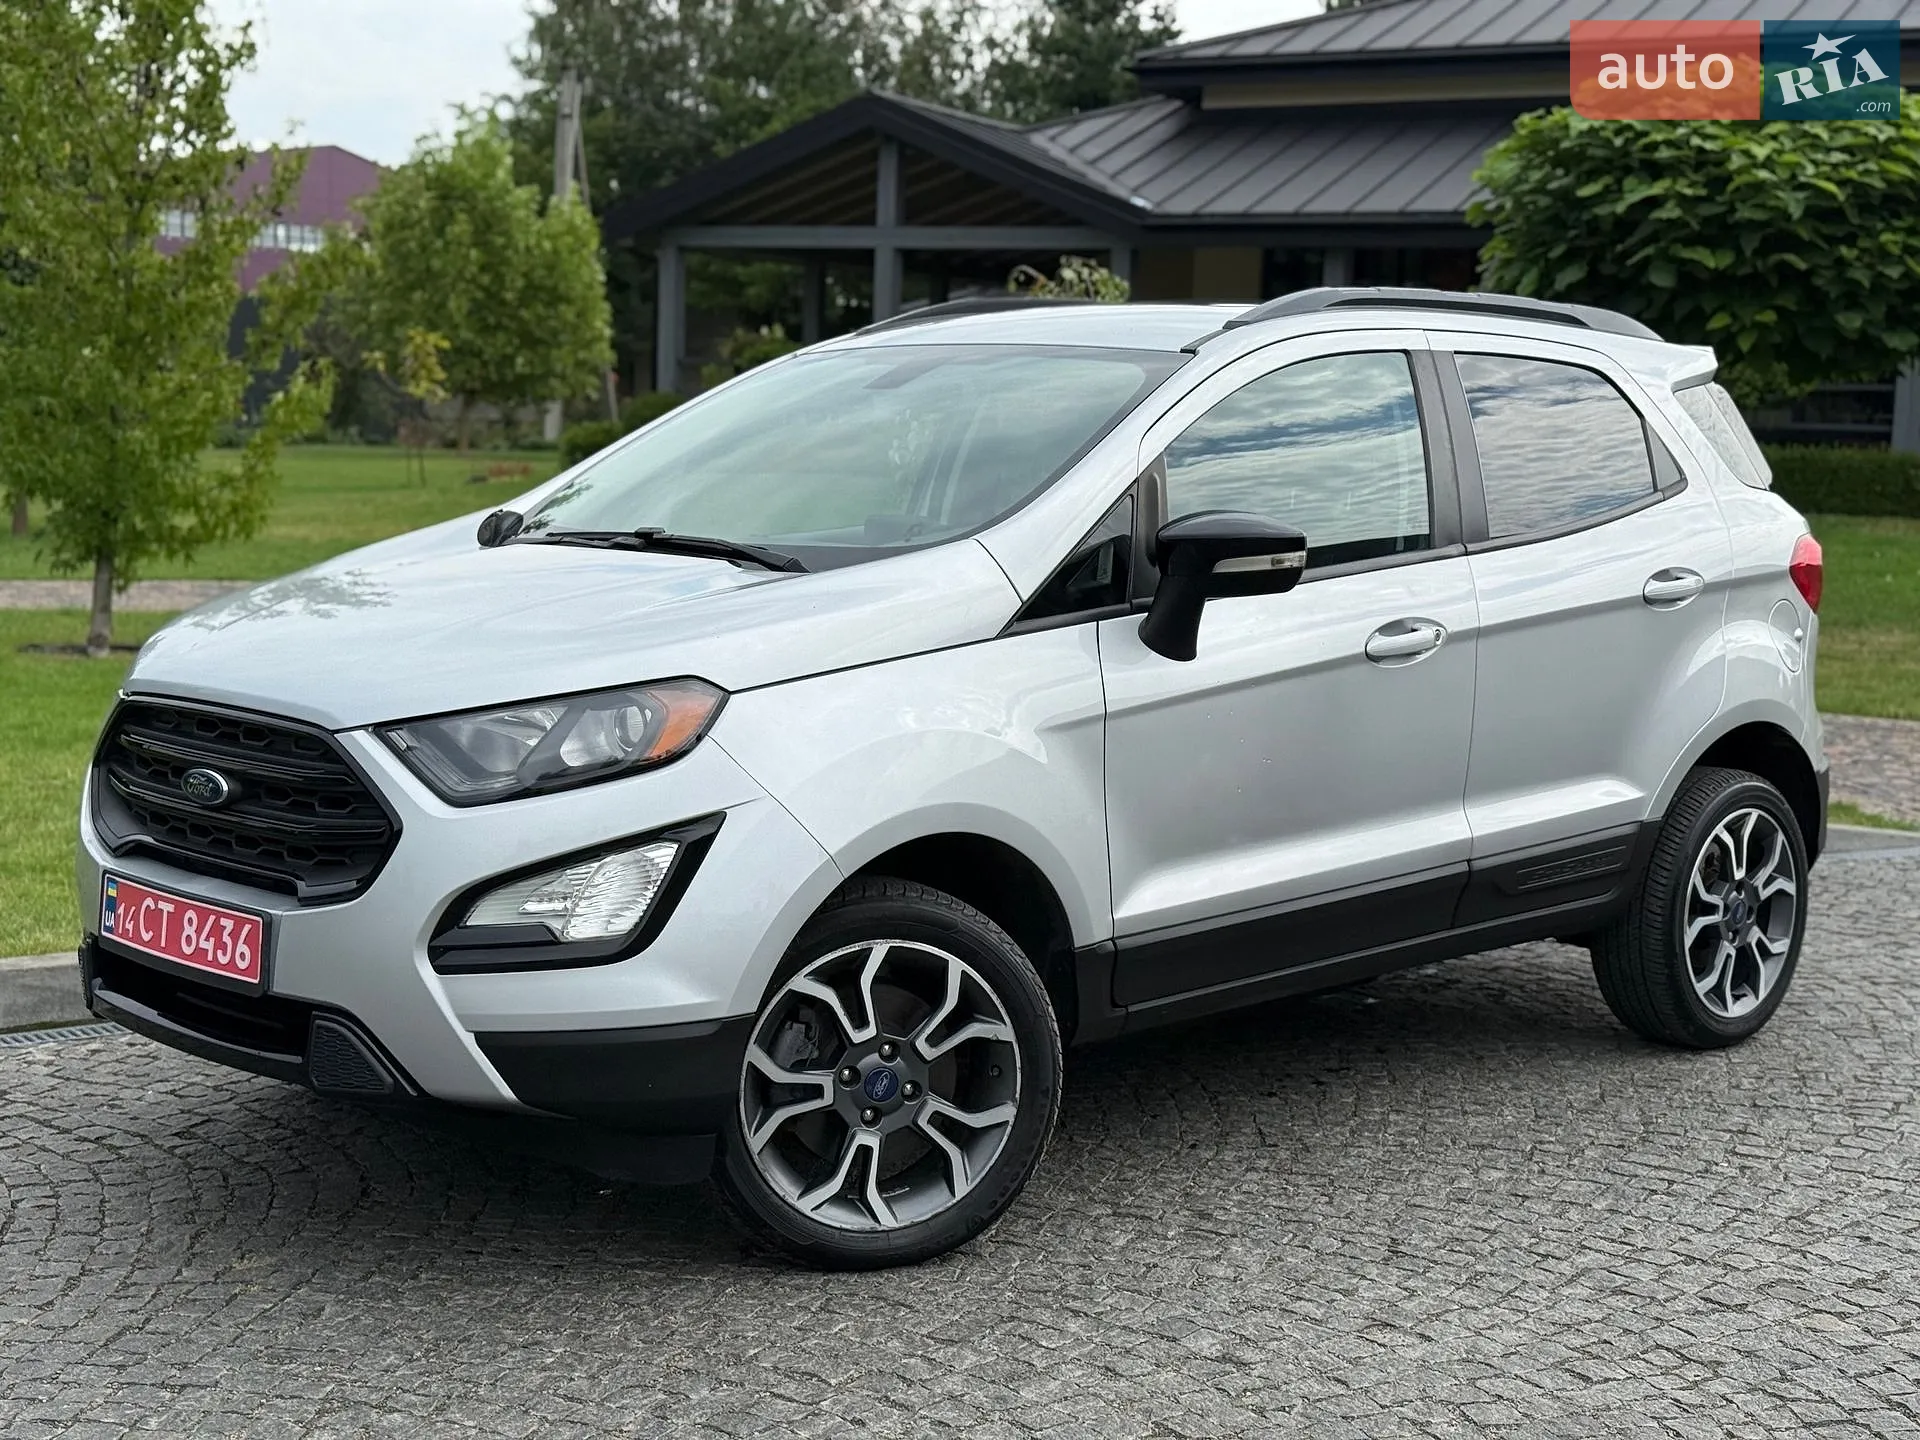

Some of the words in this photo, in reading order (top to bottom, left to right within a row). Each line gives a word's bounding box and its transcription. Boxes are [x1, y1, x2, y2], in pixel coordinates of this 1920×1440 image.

[187, 773, 213, 797] Ford
[105, 909, 115, 928] UA
[117, 902, 136, 938] 14
[139, 897, 175, 948] CT
[181, 909, 252, 970] 8436
